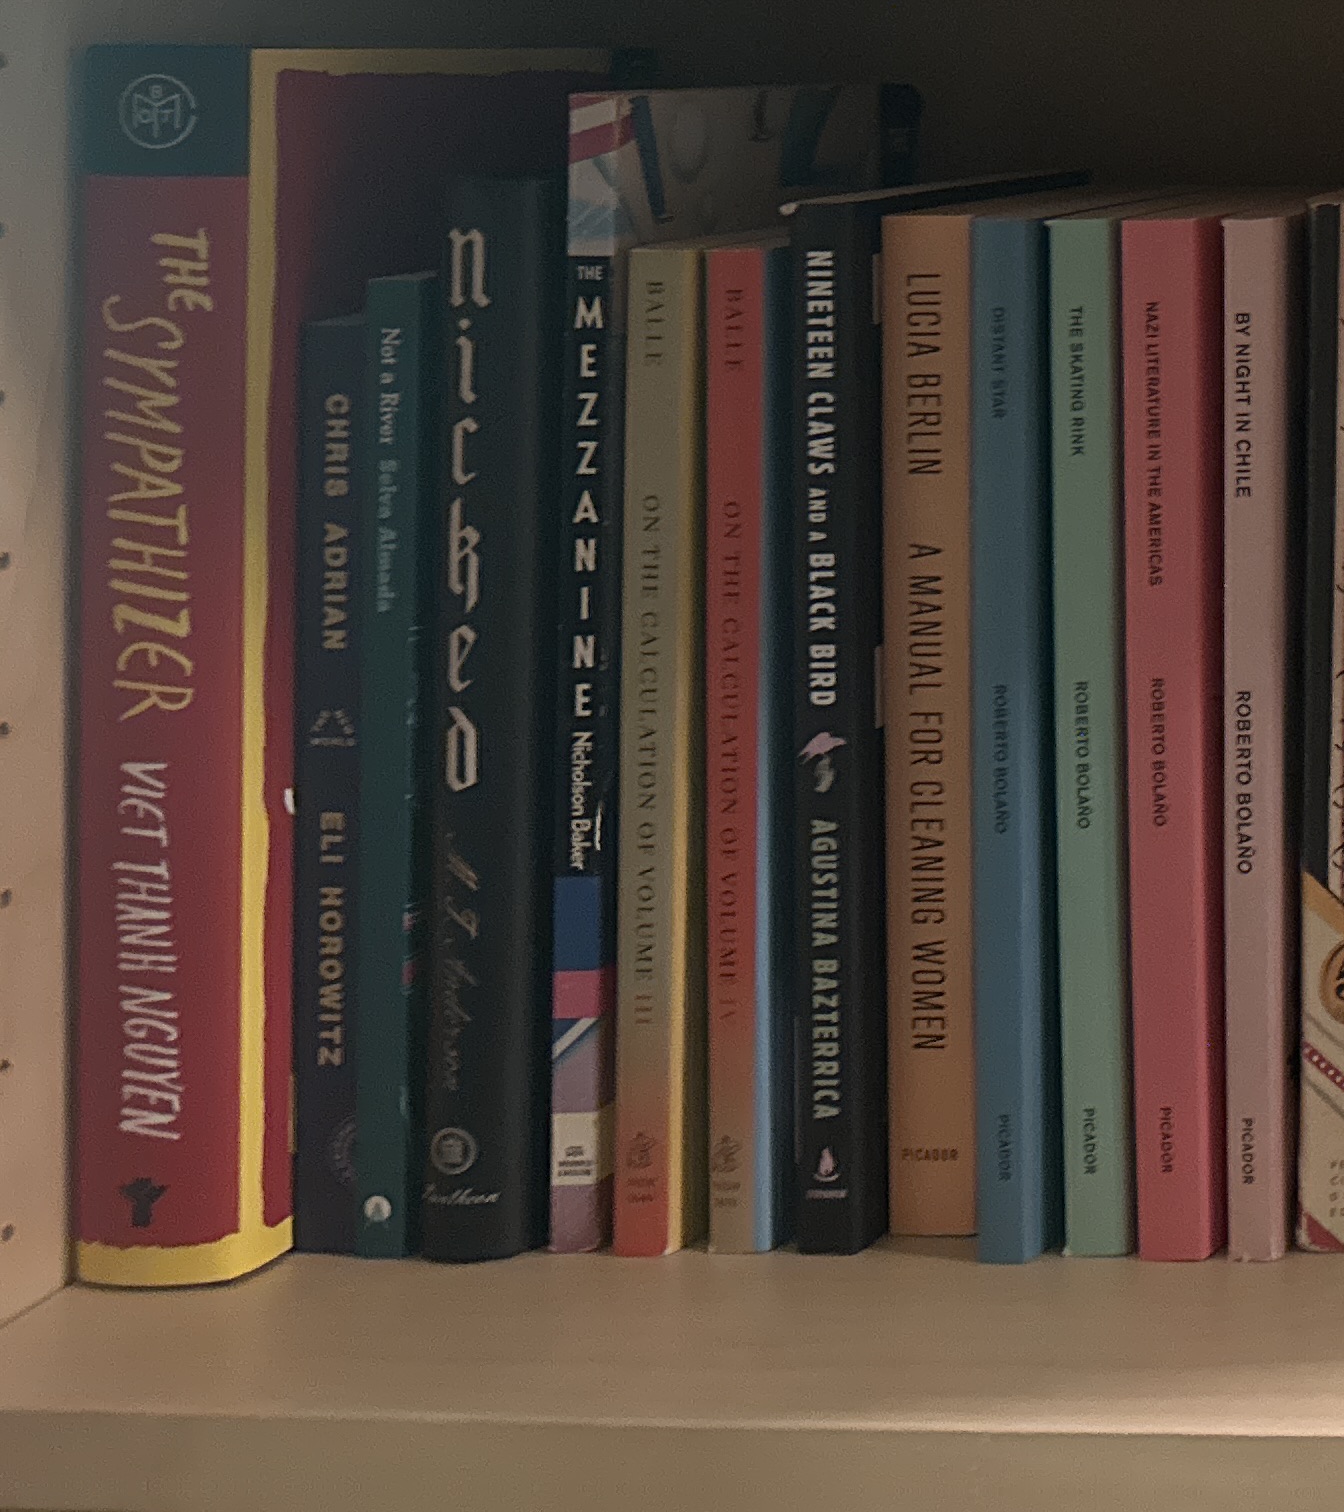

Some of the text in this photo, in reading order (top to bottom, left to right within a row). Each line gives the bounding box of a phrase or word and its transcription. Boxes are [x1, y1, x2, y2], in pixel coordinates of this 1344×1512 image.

[149, 229, 211, 312] THE
[574, 265, 601, 281] THE
[904, 273, 944, 476] LUCIA BERLIN
[1233, 312, 1252, 497] BY NIGHT IN CHILE
[103, 295, 195, 722] SYMPATHIZER
[571, 298, 601, 716] MEZZANINE
[564, 730, 593, 870] Nicholson Baker
[904, 544, 944, 1050] A MANUAL FOR CLEANING WOMEN
[1232, 690, 1258, 875] ROBERTO BOLAÑO
[110, 761, 183, 1140] VIET THANH NGUYEN
[1239, 1118, 1255, 1184] PICADOR
